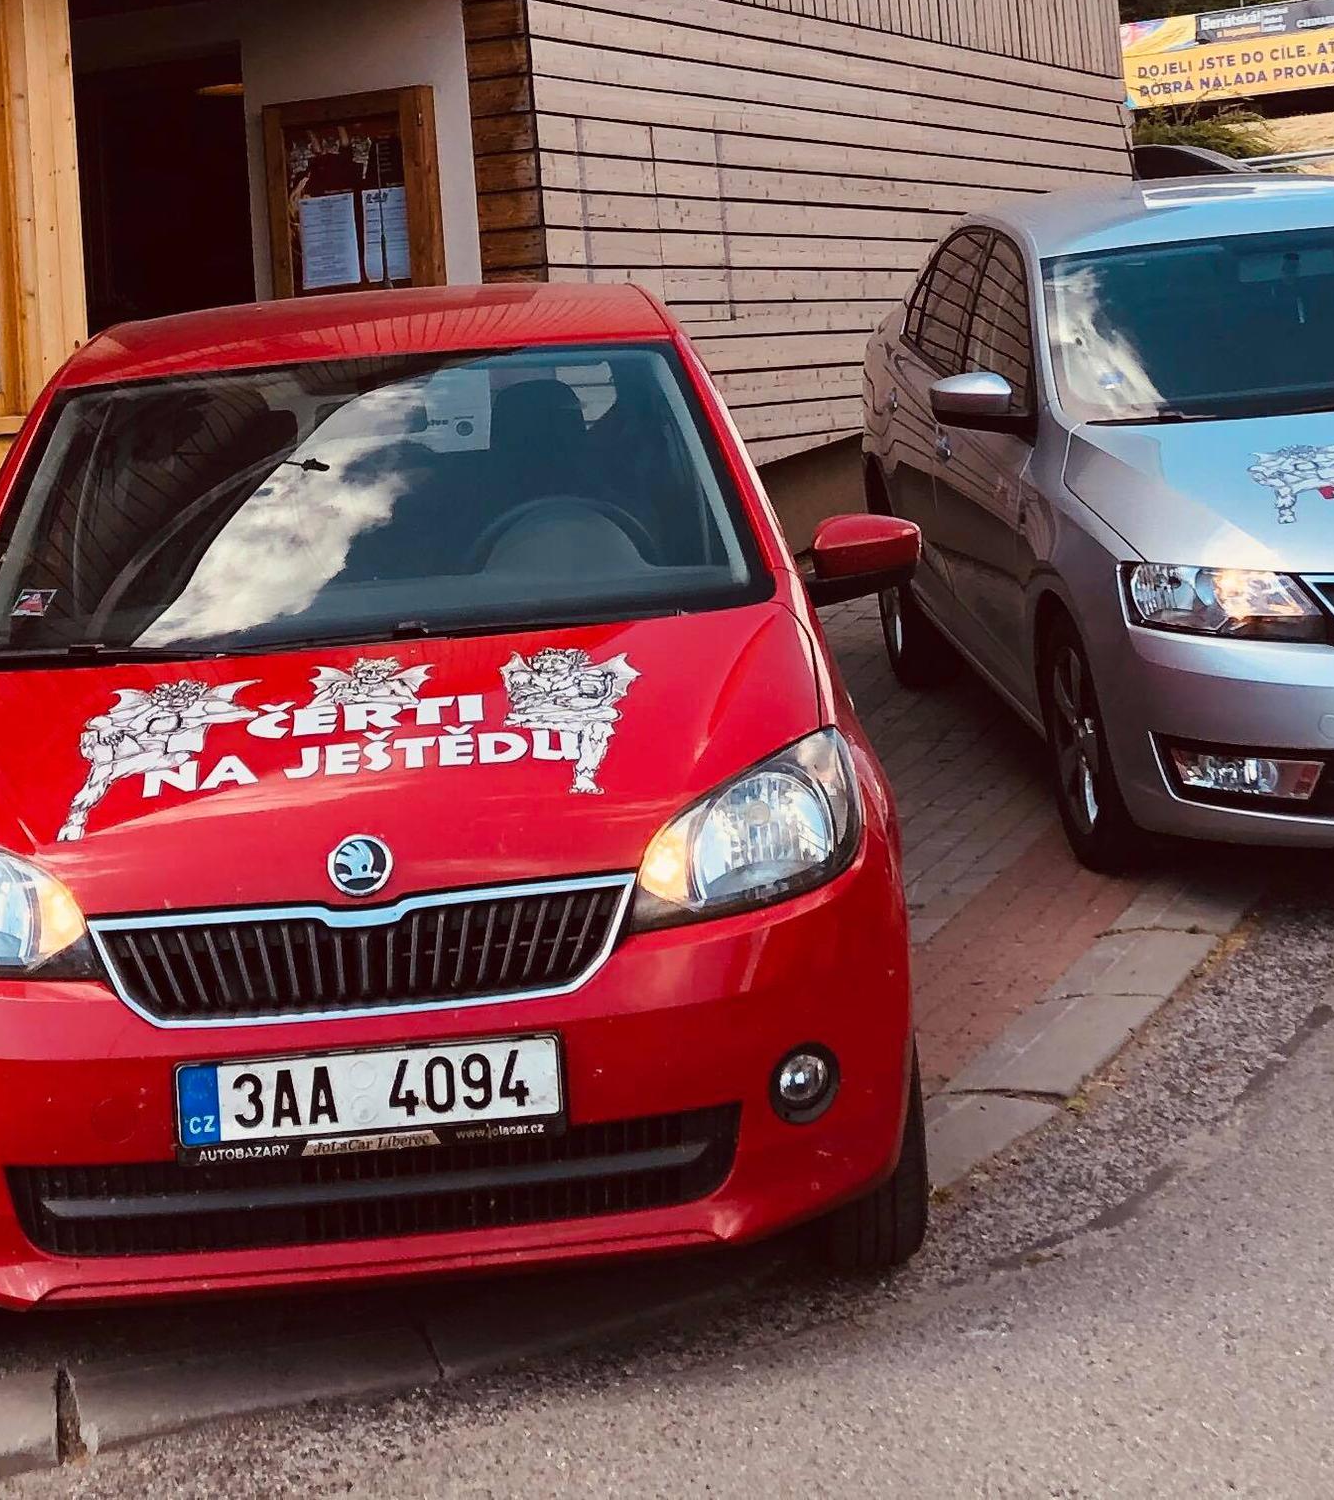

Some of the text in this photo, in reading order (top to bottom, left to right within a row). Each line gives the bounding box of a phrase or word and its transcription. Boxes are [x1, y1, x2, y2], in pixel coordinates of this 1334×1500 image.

[1138, 60, 1192, 78] DOJELI
[1198, 55, 1236, 71] JSTE
[1242, 51, 1264, 65] DO
[1140, 76, 1195, 97] DOBRÁ
[1200, 65, 1267, 89] NÁLADA
[245, 693, 485, 741] ČERTI
[141, 724, 584, 798] NA JEŠTĚDU
[232, 1049, 530, 1129] 3AA 4094
[189, 1115, 215, 1135] CZ
[198, 1144, 290, 1162] AUTOBAZARY
